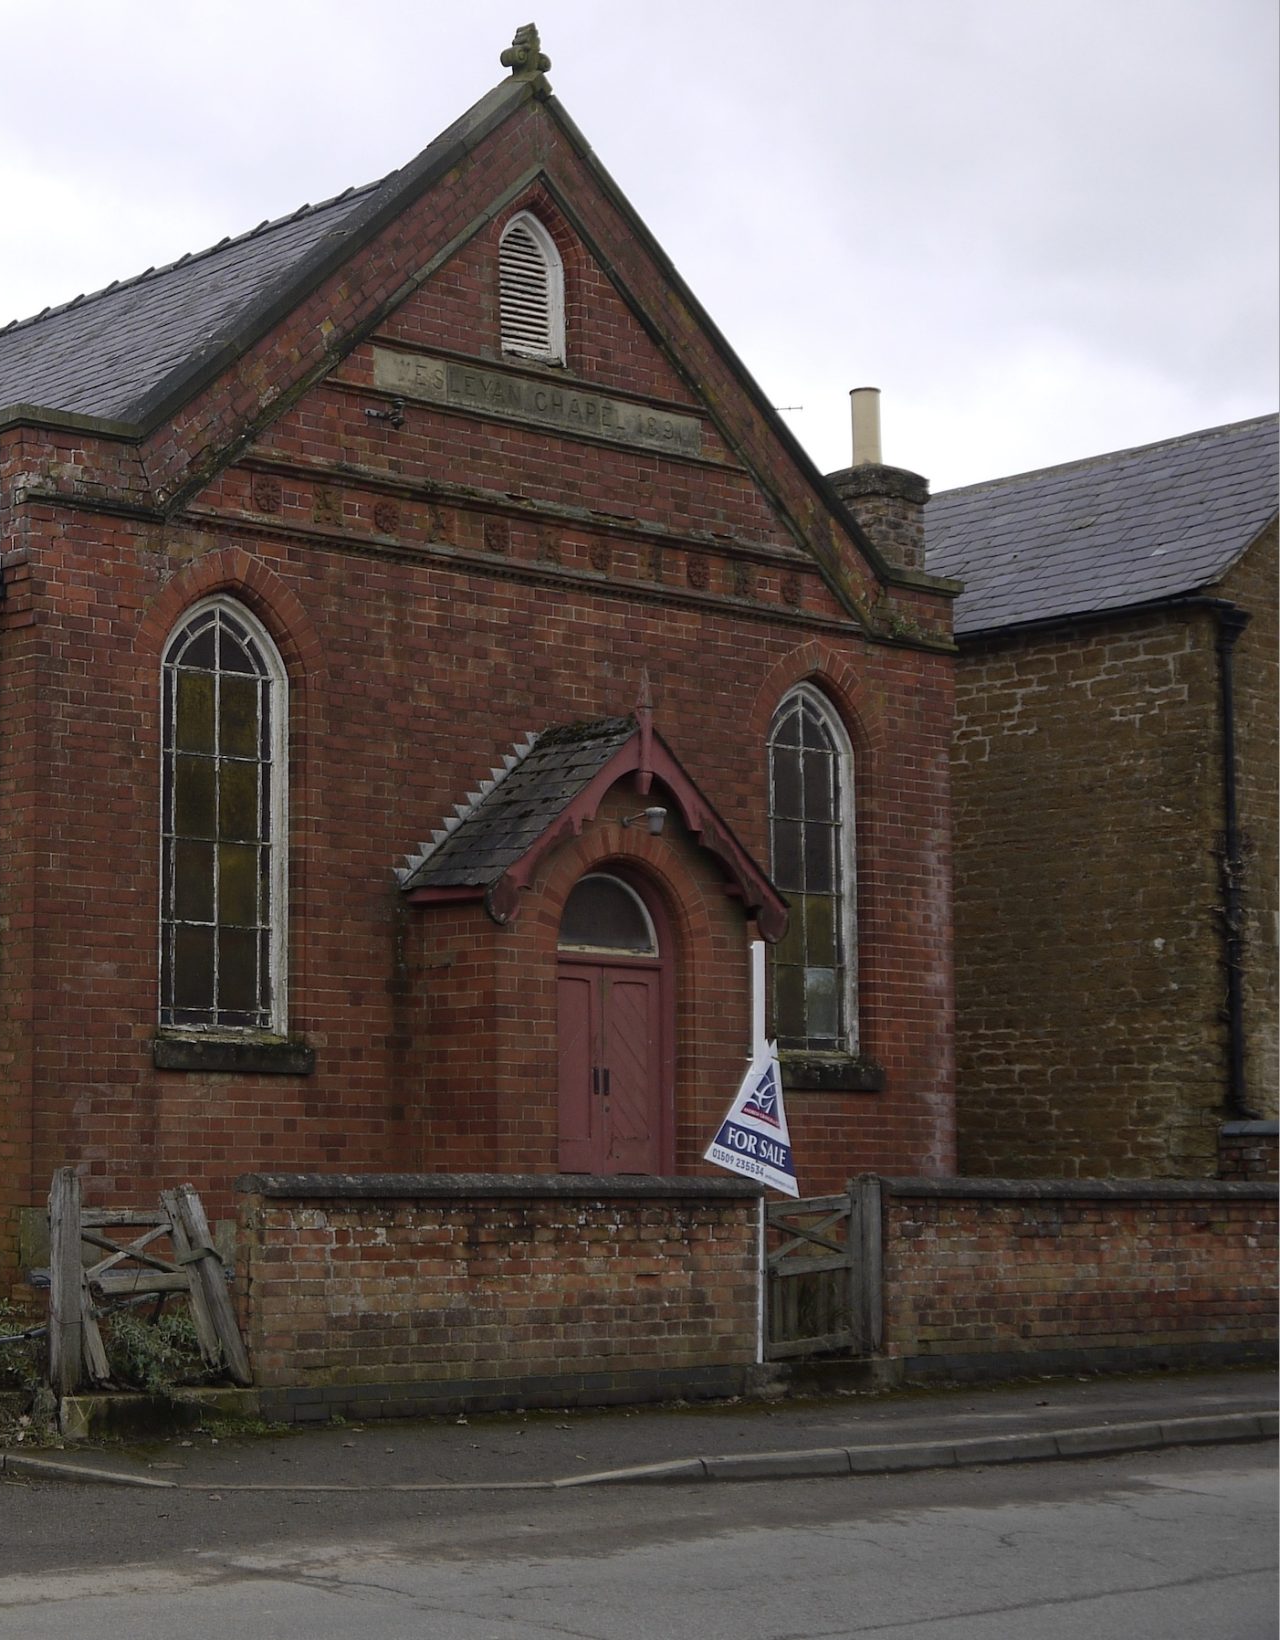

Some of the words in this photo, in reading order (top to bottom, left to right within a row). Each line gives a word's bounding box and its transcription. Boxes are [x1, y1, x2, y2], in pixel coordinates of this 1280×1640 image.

[534, 391, 626, 430] CHAPEL
[712, 1148, 735, 1165] 01509
[736, 1158, 765, 1177] 235534
[727, 1127, 758, 1155] FOR
[759, 1139, 786, 1168] SALE
